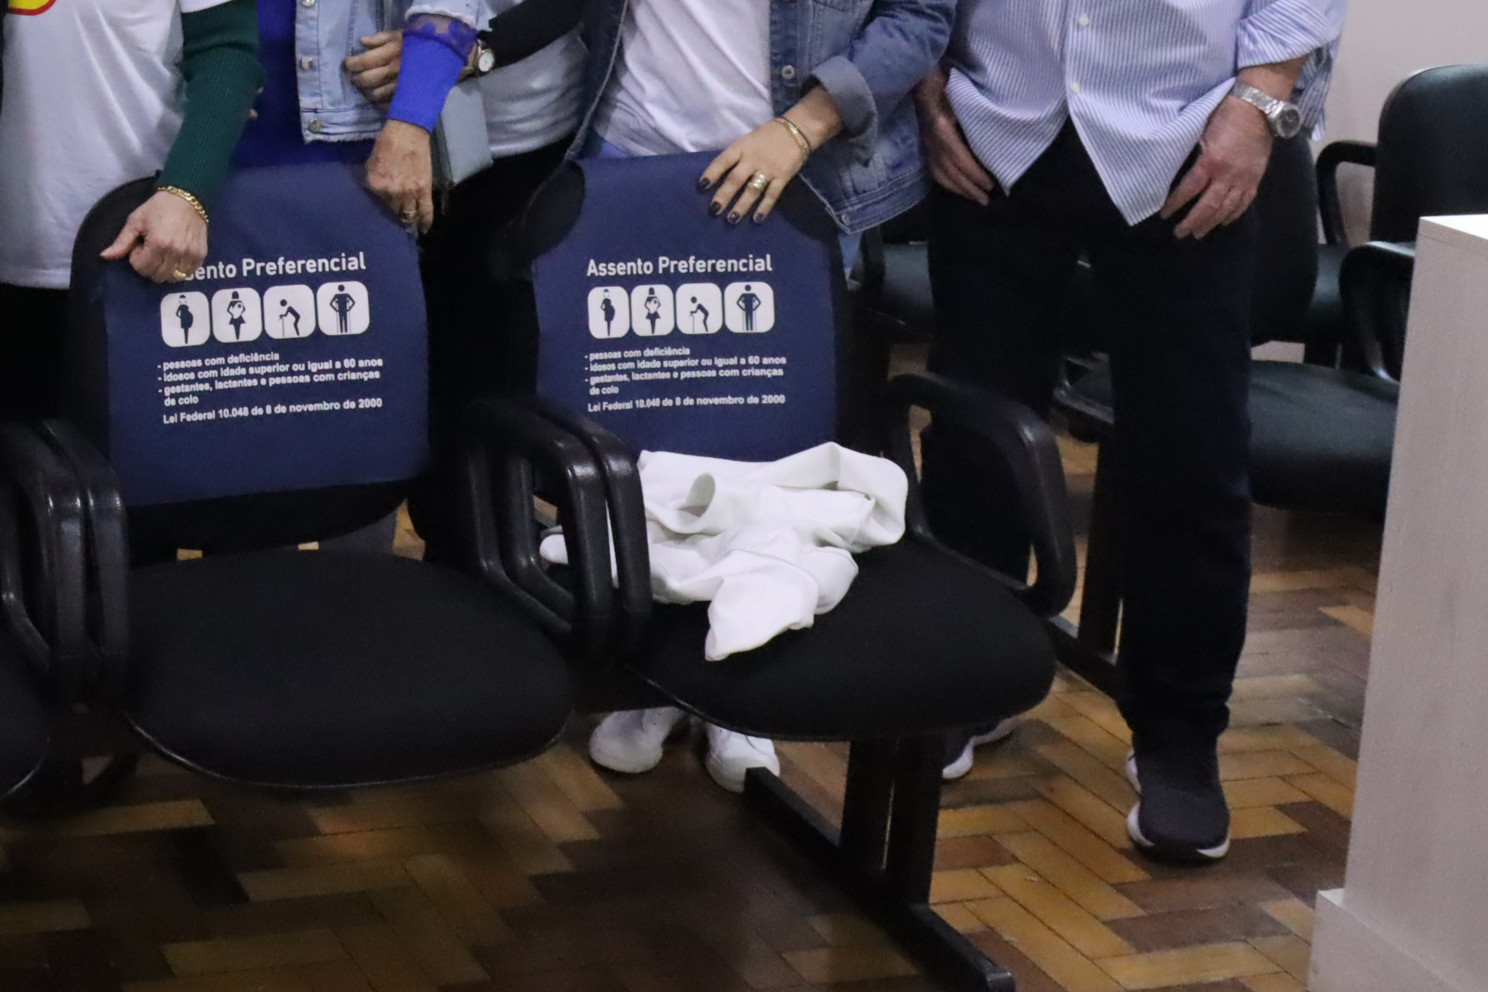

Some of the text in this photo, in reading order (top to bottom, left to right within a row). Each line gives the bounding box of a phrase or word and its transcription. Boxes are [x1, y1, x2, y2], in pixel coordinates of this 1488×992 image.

[242, 251, 367, 277] Preferencial
[586, 253, 773, 277] Assento Preferencial
[163, 359, 202, 372] pessoas
[204, 357, 225, 366] com
[227, 352, 279, 364] deficiência
[589, 351, 622, 362] pessoas
[623, 350, 642, 358] com
[590, 362, 616, 372] idosos
[617, 362, 635, 370] com
[637, 359, 661, 368] idade
[663, 358, 699, 369] superior
[714, 356, 737, 367] igual
[740, 357, 746, 365] a
[748, 355, 760, 365] 60
[762, 356, 787, 365] anos
[163, 372, 196, 382] idosos
[197, 369, 218, 379] com
[221, 365, 246, 376] idade
[248, 363, 290, 375] superior
[292, 363, 305, 371] ou
[308, 360, 332, 372] igual
[335, 361, 341, 369] a
[343, 358, 356, 368] 60
[358, 358, 383, 367] anos
[673, 371, 679, 379] e
[680, 369, 717, 380] pessoas
[718, 368, 739, 377] com
[742, 367, 784, 378] crianças
[164, 382, 212, 396] gestantes,
[215, 378, 258, 389] lactantes
[269, 375, 310, 387] pessoas
[313, 373, 335, 382] com
[337, 370, 380, 381] crianças
[589, 386, 600, 395] de
[164, 394, 199, 406] de colo
[588, 402, 601, 412] Lei
[602, 400, 633, 411] Federal
[662, 397, 673, 406] de
[683, 396, 694, 405] de
[696, 395, 745, 405] novembro
[747, 394, 759, 404] de
[761, 394, 786, 404] 2000
[163, 413, 177, 424] Lei
[180, 410, 215, 422] Federal
[218, 407, 249, 418] 10.048
[251, 406, 263, 415] de
[274, 404, 287, 414] de
[289, 401, 340, 413] novembro
[343, 399, 356, 409] de
[358, 398, 382, 408] 2000
